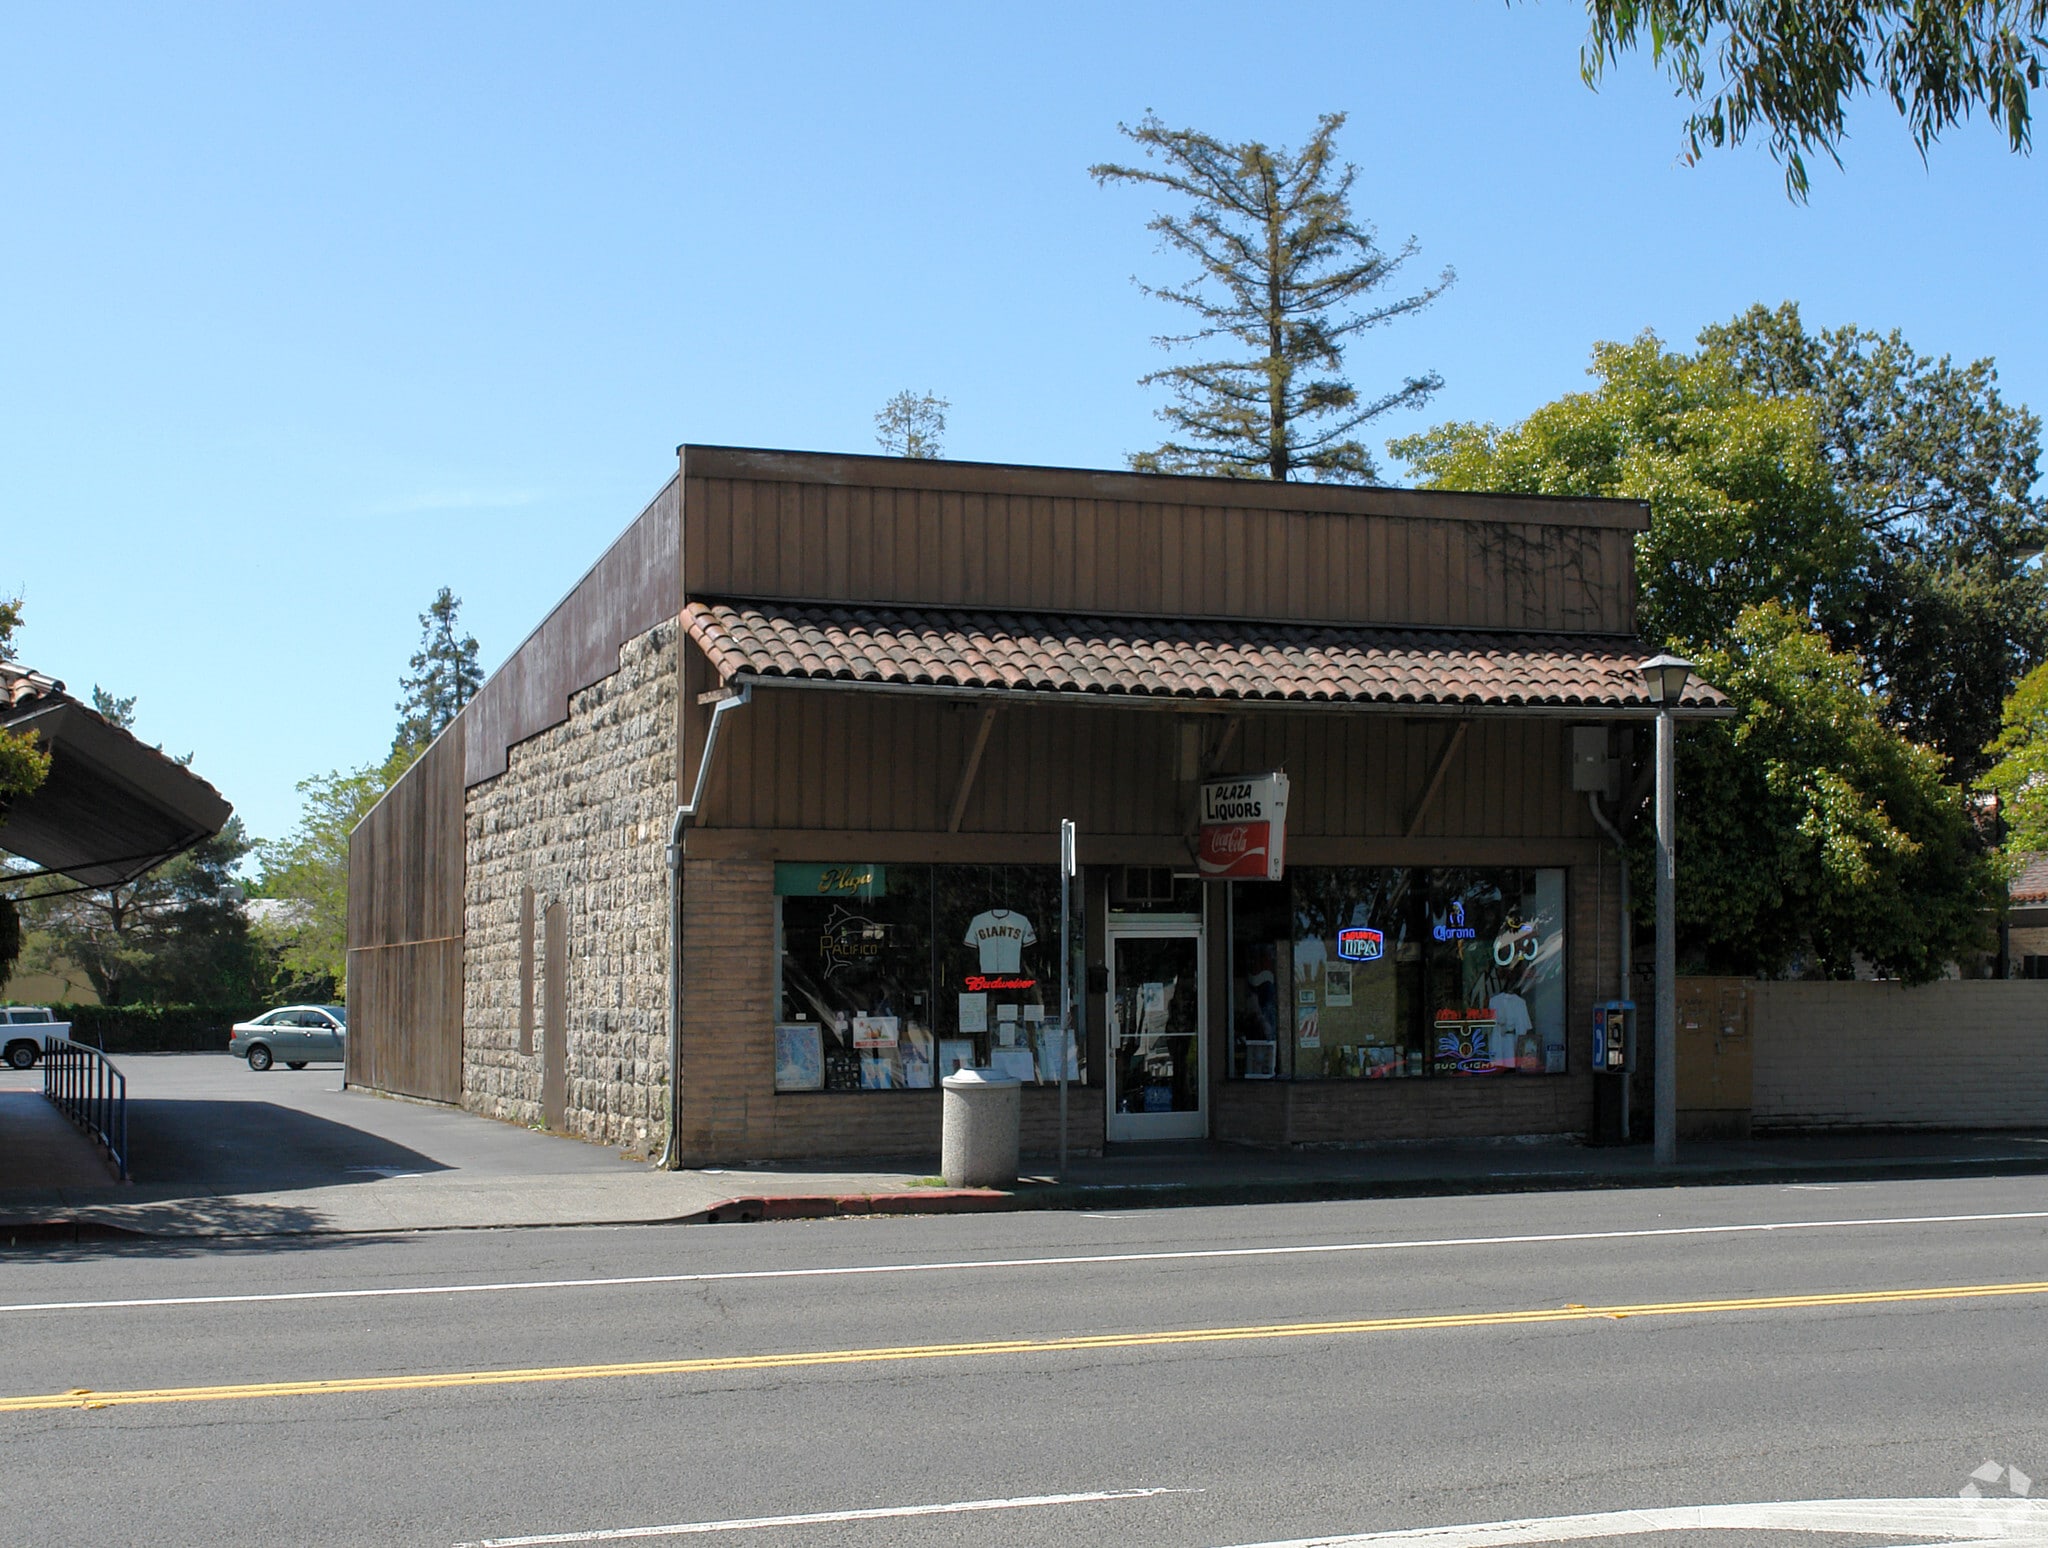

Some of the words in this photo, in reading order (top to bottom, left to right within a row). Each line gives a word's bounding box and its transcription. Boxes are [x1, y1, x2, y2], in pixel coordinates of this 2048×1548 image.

[1215, 784, 1252, 800] PLAZA
[1206, 787, 1262, 820] LIQUORS
[818, 867, 873, 894] Plaza
[978, 925, 1022, 940] GIANTS
[1433, 925, 1476, 942] Corona
[1345, 939, 1378, 956] IPA
[964, 975, 1037, 991] Budweiser
